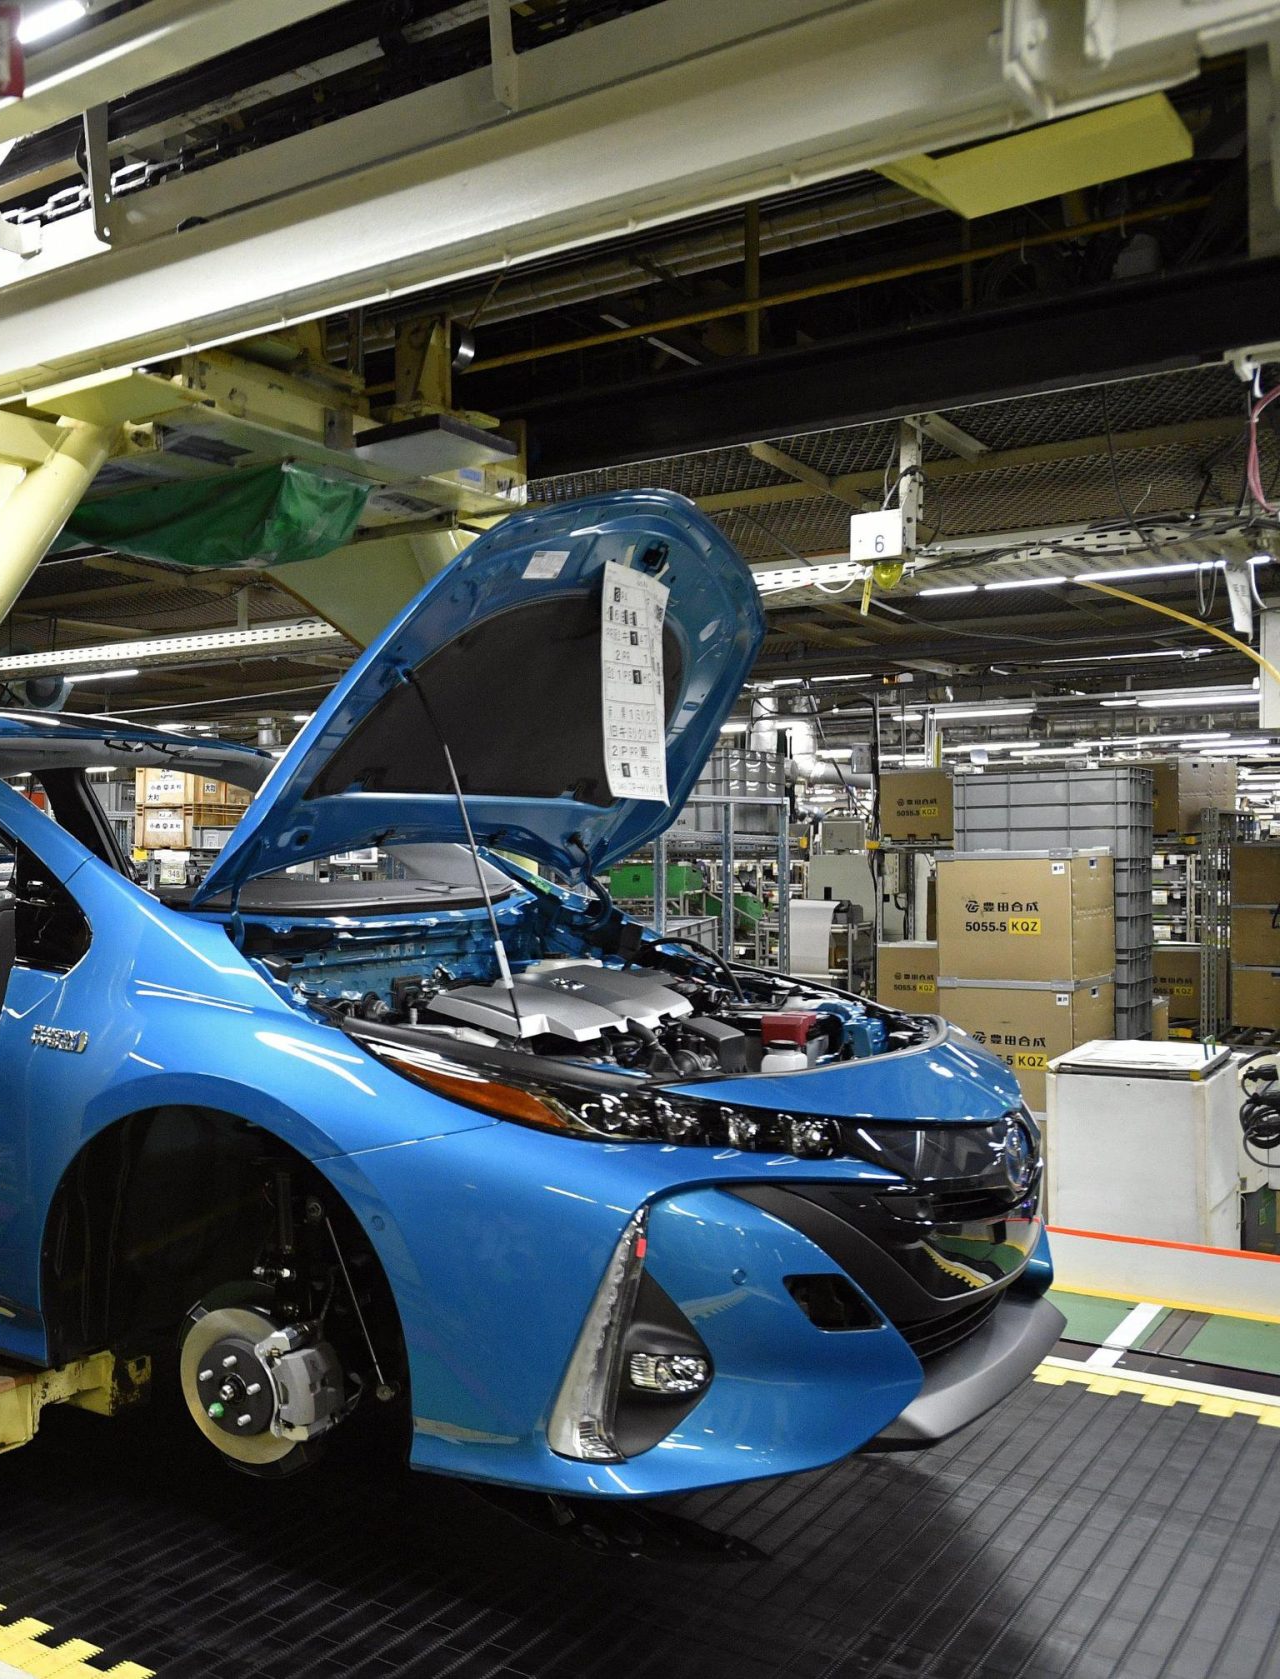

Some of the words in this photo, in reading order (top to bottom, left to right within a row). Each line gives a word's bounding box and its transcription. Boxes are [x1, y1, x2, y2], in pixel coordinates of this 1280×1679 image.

[875, 534, 885, 553] 6
[965, 922, 1007, 932] 5055.5
[1011, 921, 1038, 931] KQZ
[1018, 1056, 1044, 1067] KQZ
